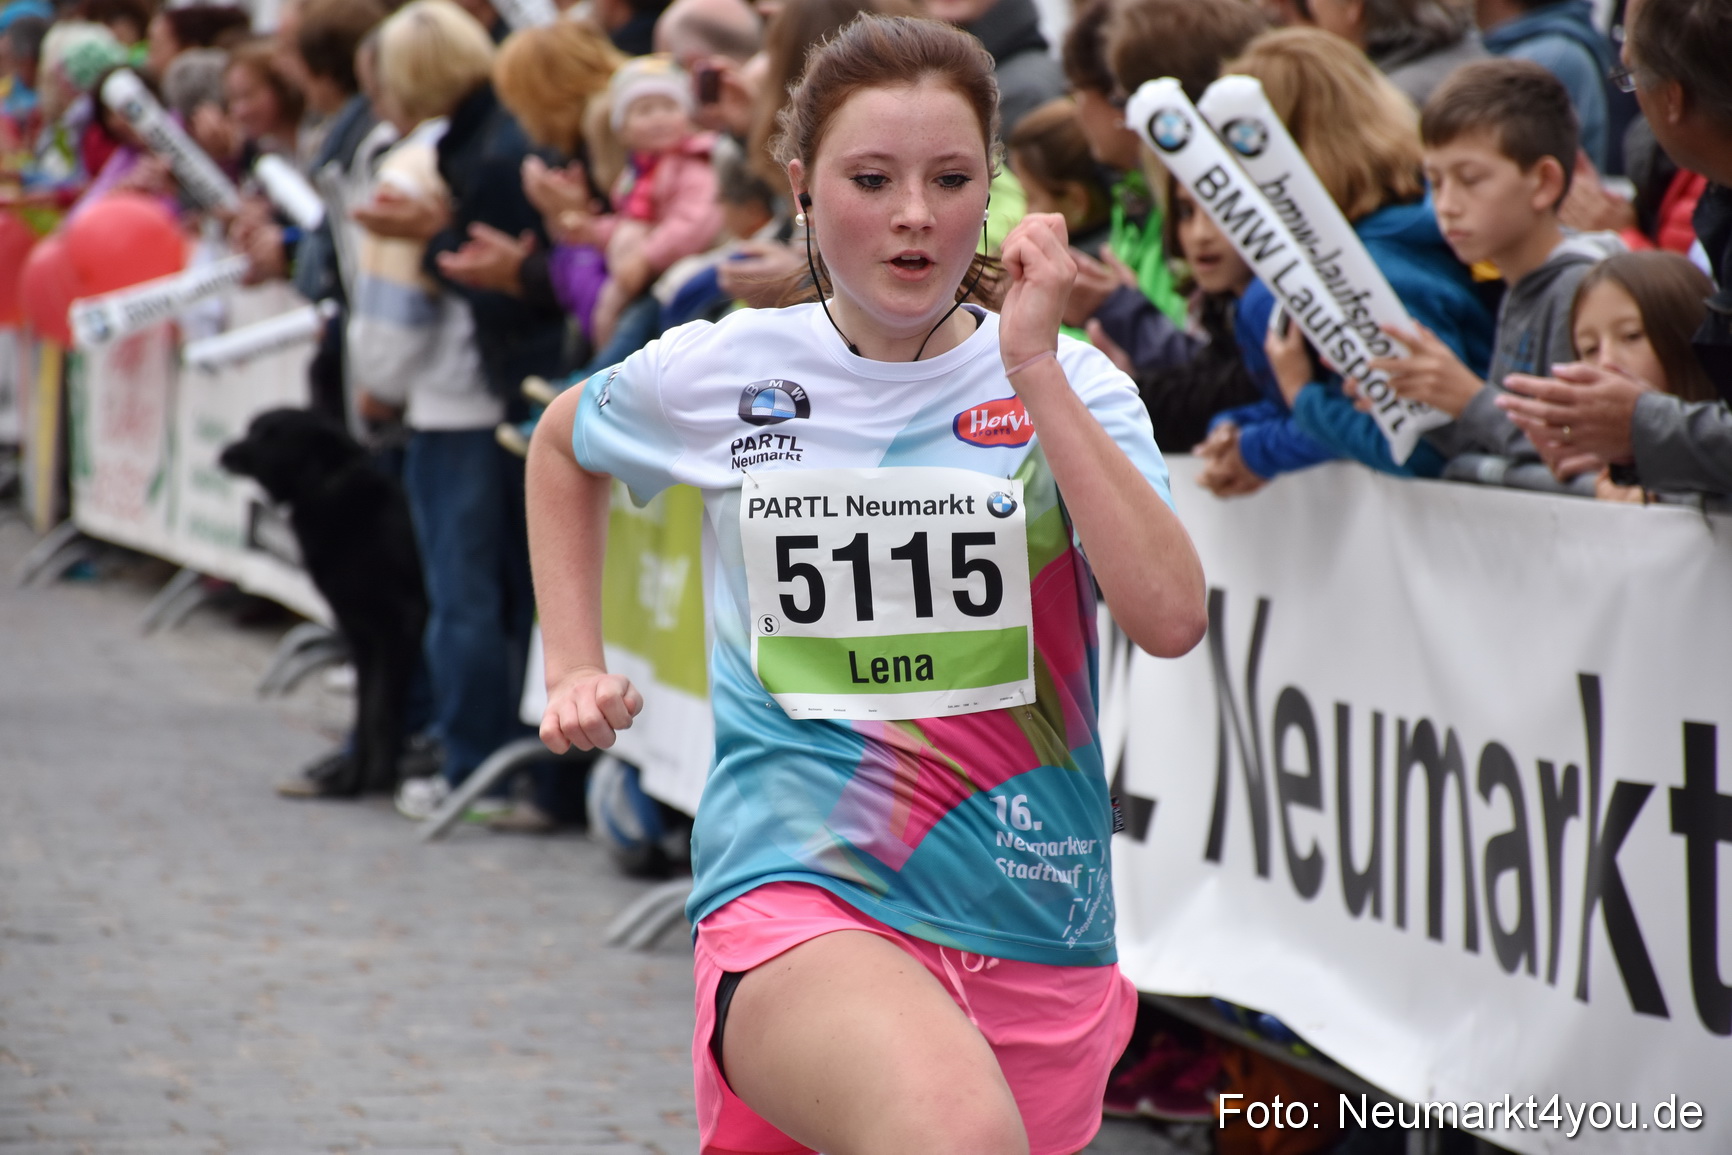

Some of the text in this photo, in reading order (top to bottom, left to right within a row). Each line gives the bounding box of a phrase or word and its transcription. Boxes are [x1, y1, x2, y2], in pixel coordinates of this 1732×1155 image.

[1195, 165, 1286, 263] BMW
[745, 380, 806, 402] BMW
[969, 405, 1034, 434] Hervi
[972, 428, 1011, 438] SPORTS
[730, 433, 804, 456] PARTL
[731, 451, 802, 470] Neumarkt
[748, 495, 839, 519] PARTL
[846, 494, 976, 518] Neumarkt
[775, 531, 1004, 625] 5115
[848, 650, 935, 684] Lena
[989, 794, 1043, 831] 16.
[1203, 586, 1732, 1038] Neumarkt
